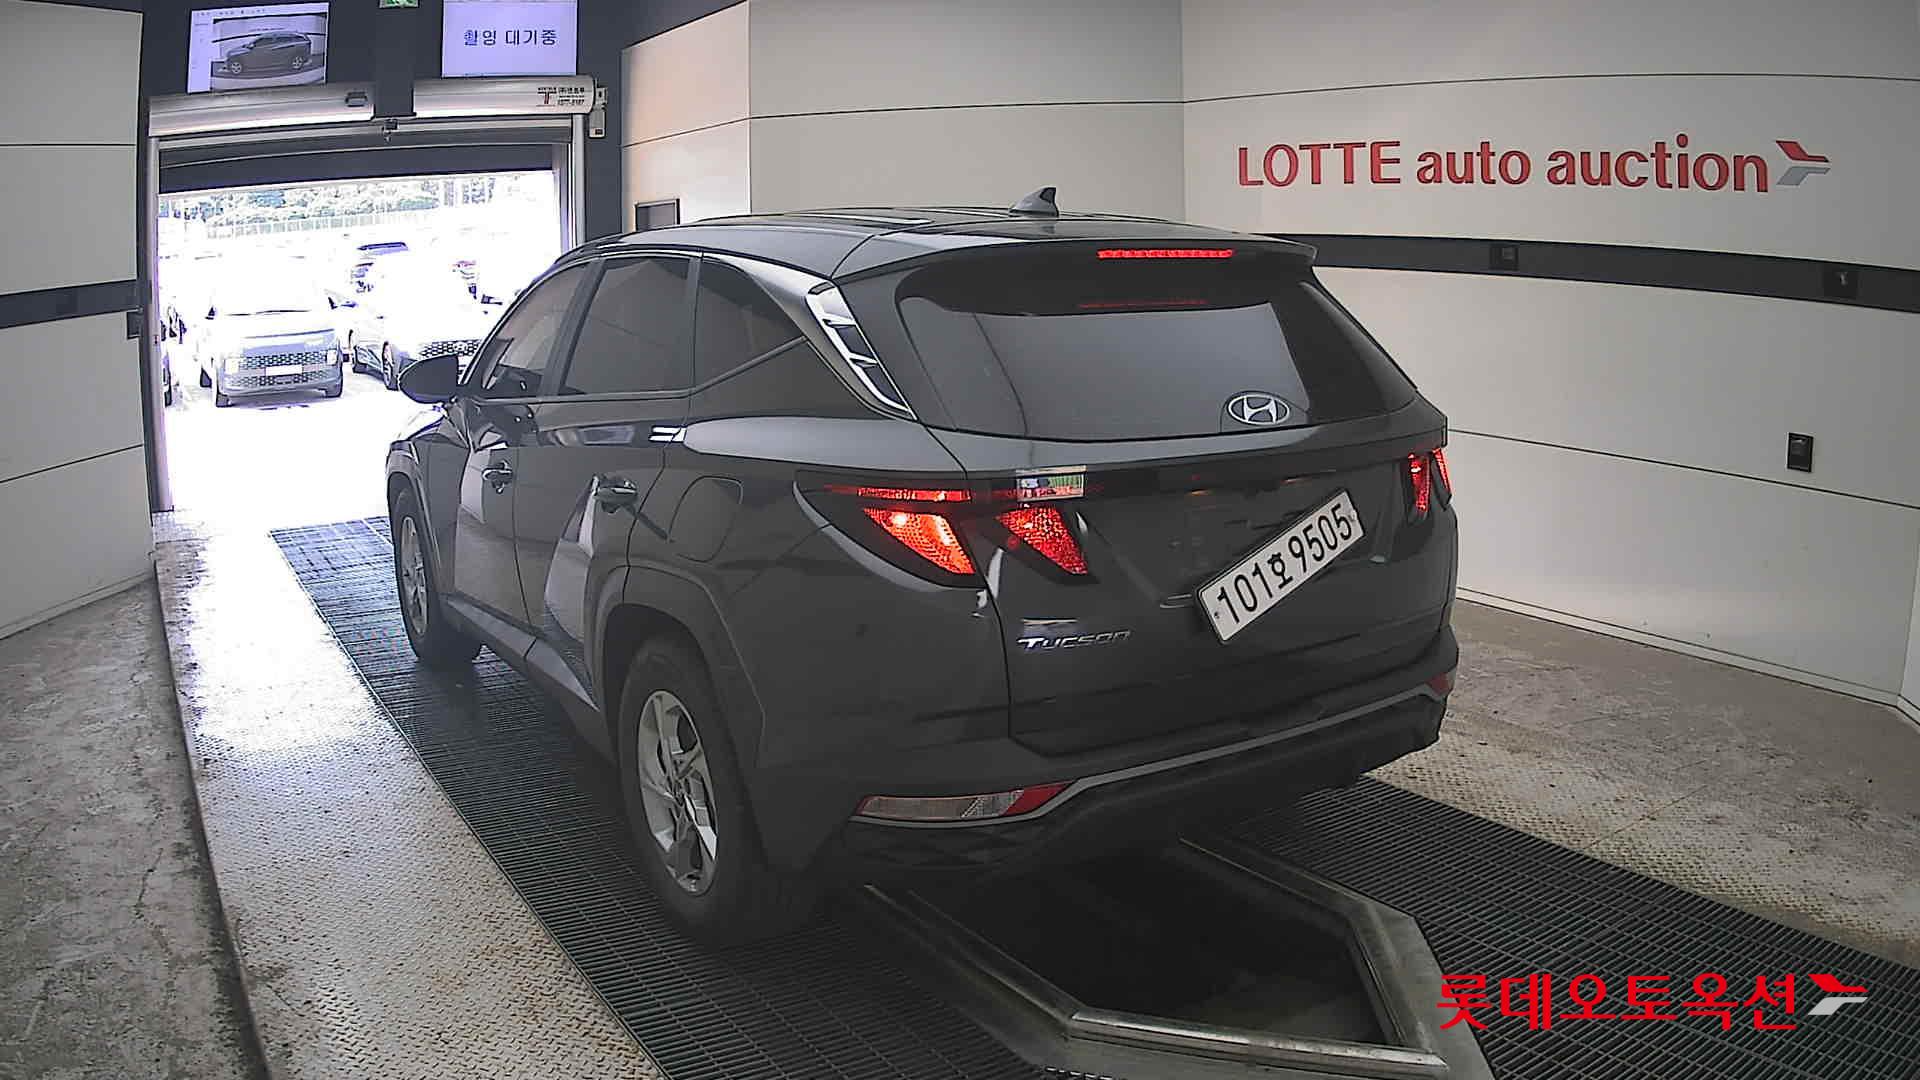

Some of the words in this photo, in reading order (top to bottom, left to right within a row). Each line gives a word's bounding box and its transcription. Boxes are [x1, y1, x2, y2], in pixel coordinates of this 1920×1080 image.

[504, 29, 558, 46] 대기중
[1237, 140, 1401, 187] LOTTE
[1416, 141, 1532, 186] auto
[1547, 134, 1769, 193] auction
